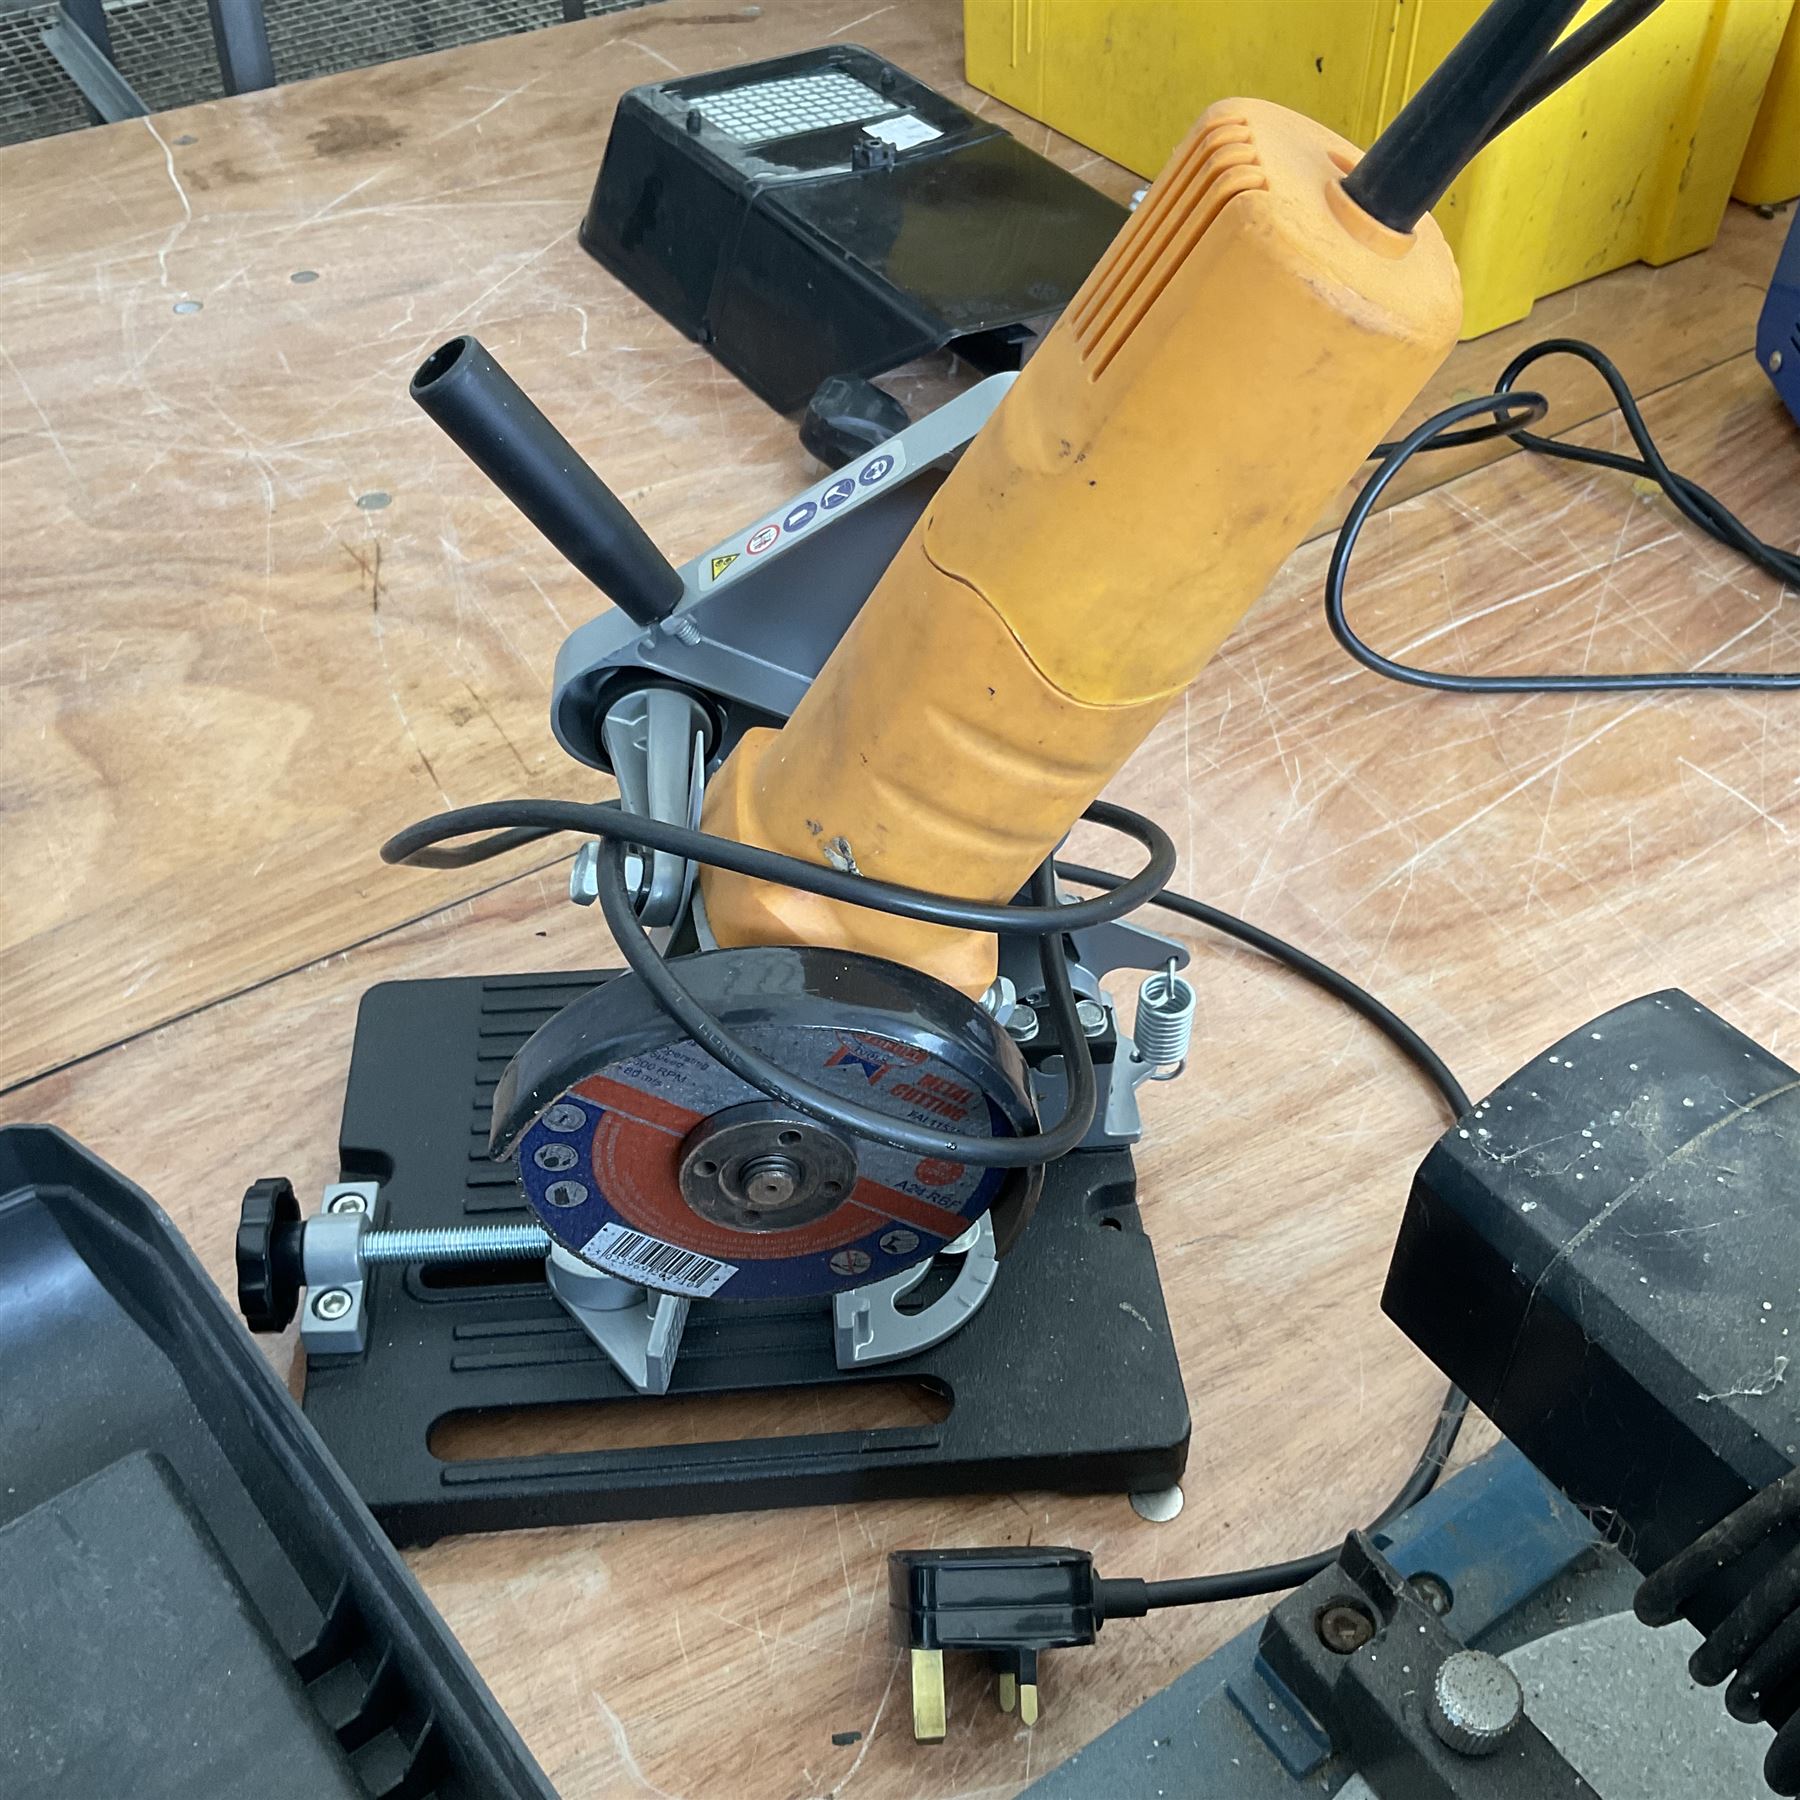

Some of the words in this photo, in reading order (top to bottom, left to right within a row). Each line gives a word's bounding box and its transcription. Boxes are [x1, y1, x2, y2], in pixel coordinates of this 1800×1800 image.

[657, 1067, 687, 1083] RPM
[917, 1073, 974, 1104] METAL
[890, 1083, 968, 1120] CUTTING
